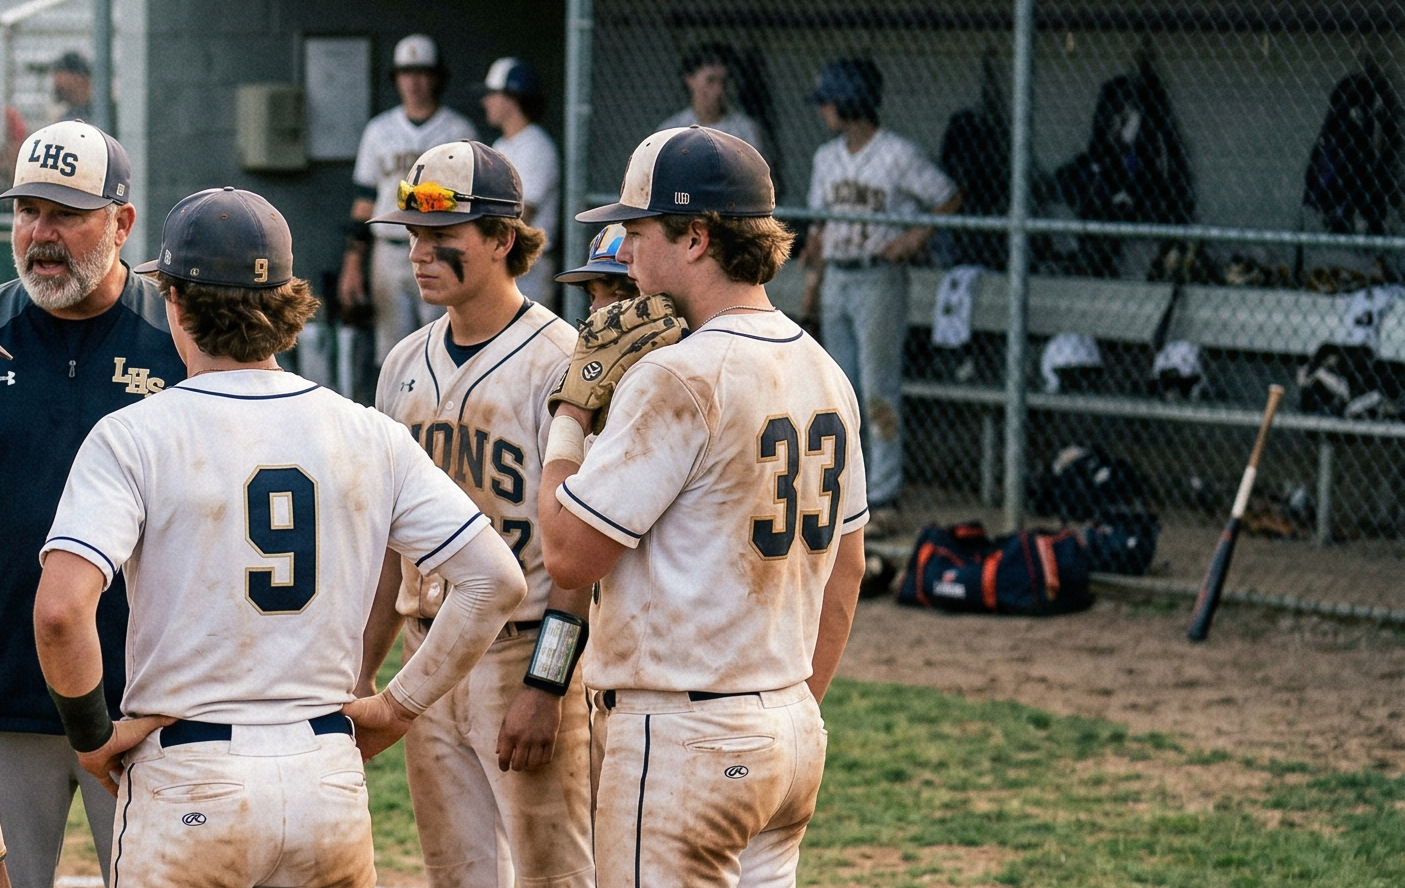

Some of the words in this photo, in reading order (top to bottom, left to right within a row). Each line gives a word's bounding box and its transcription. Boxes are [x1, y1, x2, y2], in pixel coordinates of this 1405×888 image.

[28, 139, 78, 177] LHS
[254, 258, 268, 282] 9
[112, 357, 165, 398] LHS
[409, 419, 526, 507] ONS
[748, 408, 849, 562] 33
[243, 463, 320, 617] 9
[486, 515, 535, 572] 7
